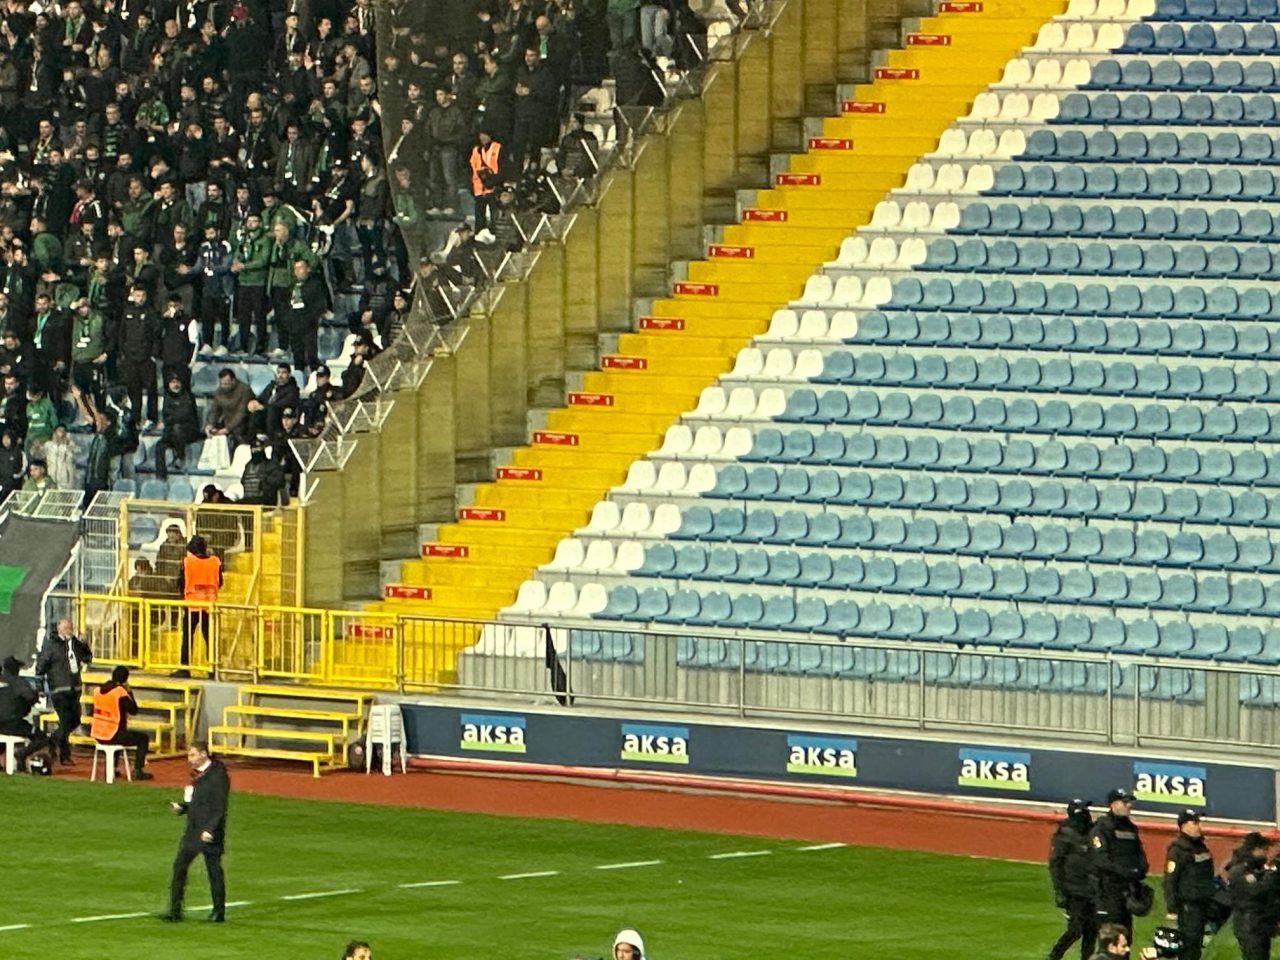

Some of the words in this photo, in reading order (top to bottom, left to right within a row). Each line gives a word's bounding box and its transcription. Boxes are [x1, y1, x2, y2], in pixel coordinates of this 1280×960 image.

[462, 723, 524, 748] aksa
[623, 733, 687, 758] aksa
[790, 744, 855, 771] aksa
[960, 757, 1028, 784] aksa
[1135, 771, 1204, 799] aksa
